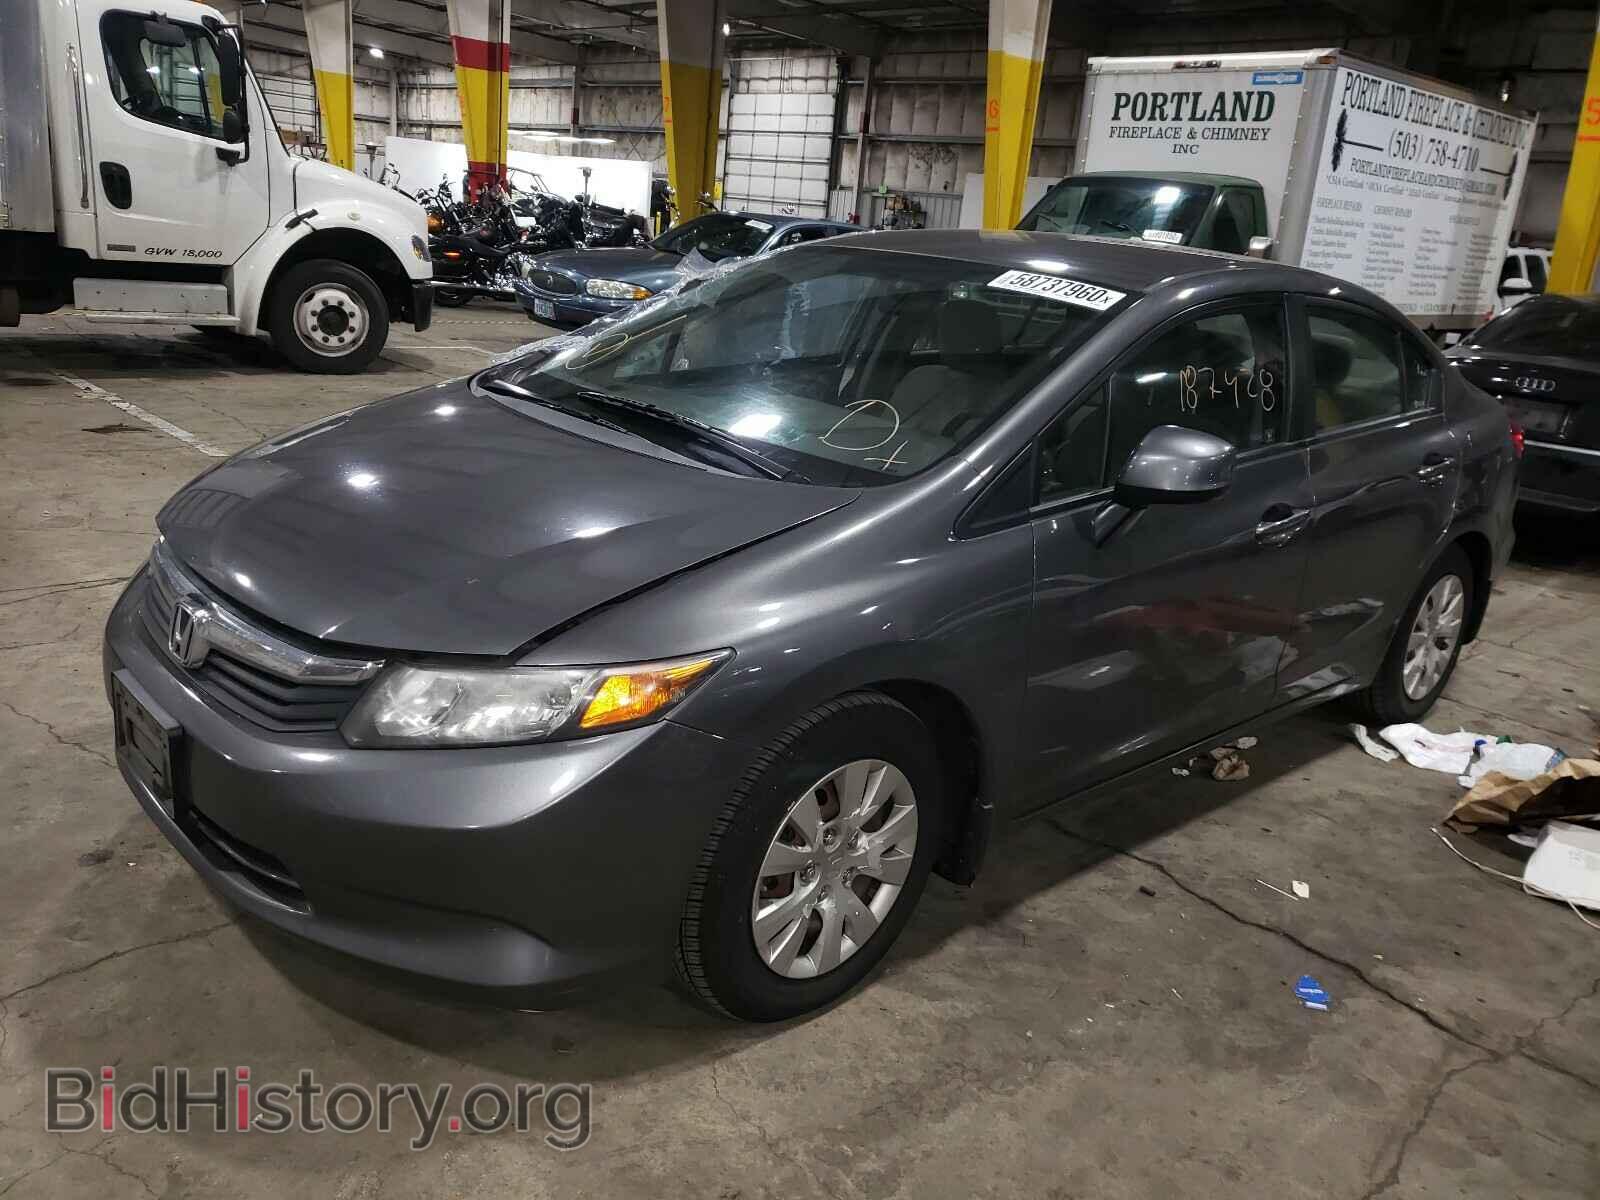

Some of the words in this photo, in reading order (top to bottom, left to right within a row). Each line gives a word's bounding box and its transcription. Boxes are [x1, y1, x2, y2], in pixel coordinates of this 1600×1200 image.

[1111, 91, 1276, 122] PORTLAND
[1340, 71, 1407, 119] PORTLAND
[1405, 89, 1465, 132] FIREPLACE
[1108, 126, 1183, 140] FIREPLACE
[1186, 126, 1199, 140] &
[1201, 126, 1271, 141] CHIMNEY
[1171, 143, 1200, 155] INC
[1388, 127, 1425, 163] (503)
[1424, 136, 1481, 173] 758-4710
[144, 247, 178, 256] GVW
[182, 249, 223, 258] 18,000
[1010, 273, 1108, 302] 58737960
